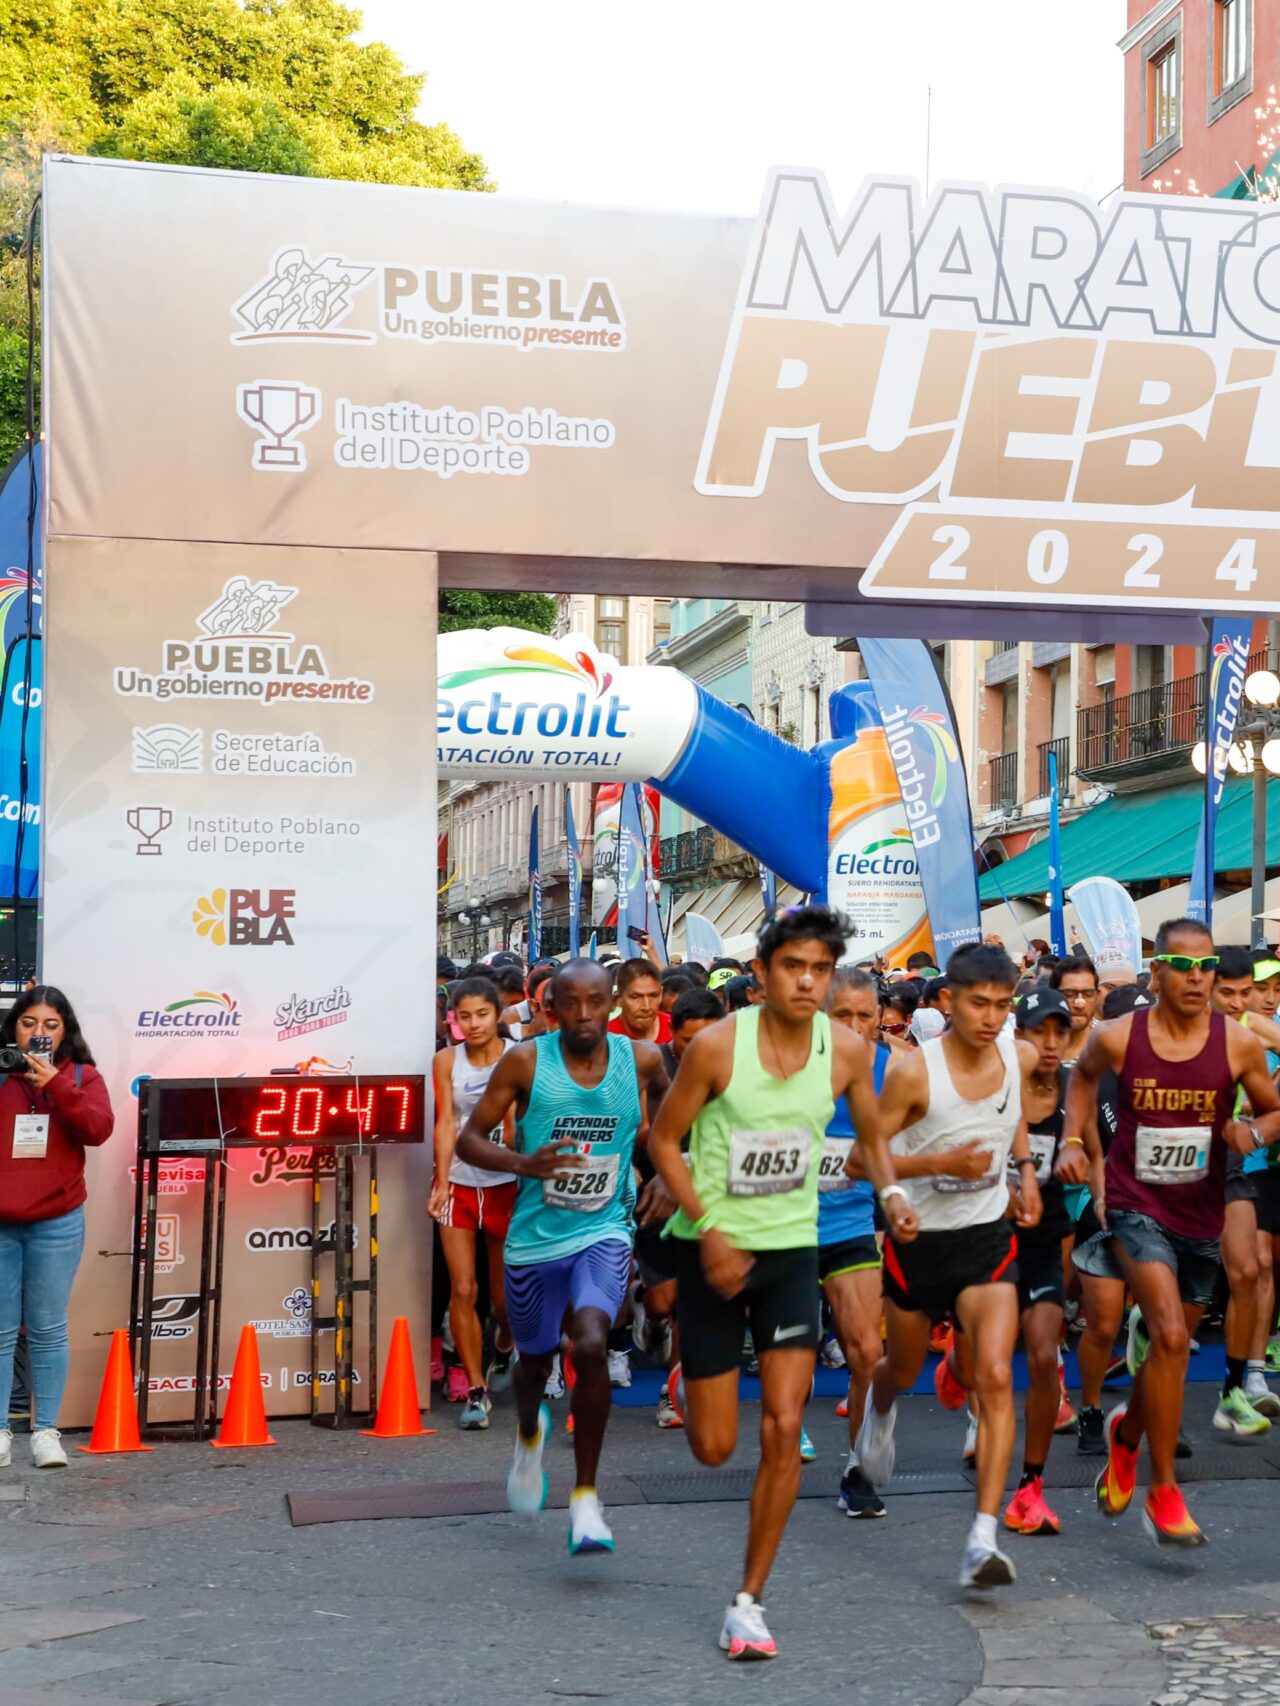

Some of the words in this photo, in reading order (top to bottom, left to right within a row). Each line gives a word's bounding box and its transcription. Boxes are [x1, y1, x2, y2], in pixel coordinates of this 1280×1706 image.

[384, 267, 622, 324] PUEBLA
[385, 312, 417, 334] Un
[420, 316, 521, 343] gobierno
[522, 326, 622, 348] presente
[340, 401, 474, 437] Instituto
[487, 411, 611, 445] Poblano
[340, 434, 389, 464] del
[400, 438, 524, 476] Deporte
[929, 525, 1258, 591] 2024
[166, 644, 325, 676] PUEBLA
[117, 670, 152, 693] Un
[156, 673, 263, 698] gobierno
[265, 679, 370, 702] presente
[215, 732, 320, 753] Secretaría
[215, 754, 240, 771] de
[247, 754, 353, 775] Educación
[542, 751, 622, 766] TOTAL!
[187, 816, 273, 834] Instituto
[280, 817, 361, 835] Poblano
[187, 835, 217, 852] del
[224, 836, 305, 856] Deporte
[137, 1010, 242, 1027] Electrolit
[206, 1030, 240, 1038] TOTAL!
[1132, 1088, 1217, 1111] ZATOPEK
[555, 1117, 618, 1129] LEYENDAS
[550, 1129, 614, 1142] RUNNERS
[740, 1148, 800, 1177] 4853
[1149, 1145, 1198, 1167] 3710
[553, 1171, 609, 1195] 6528
